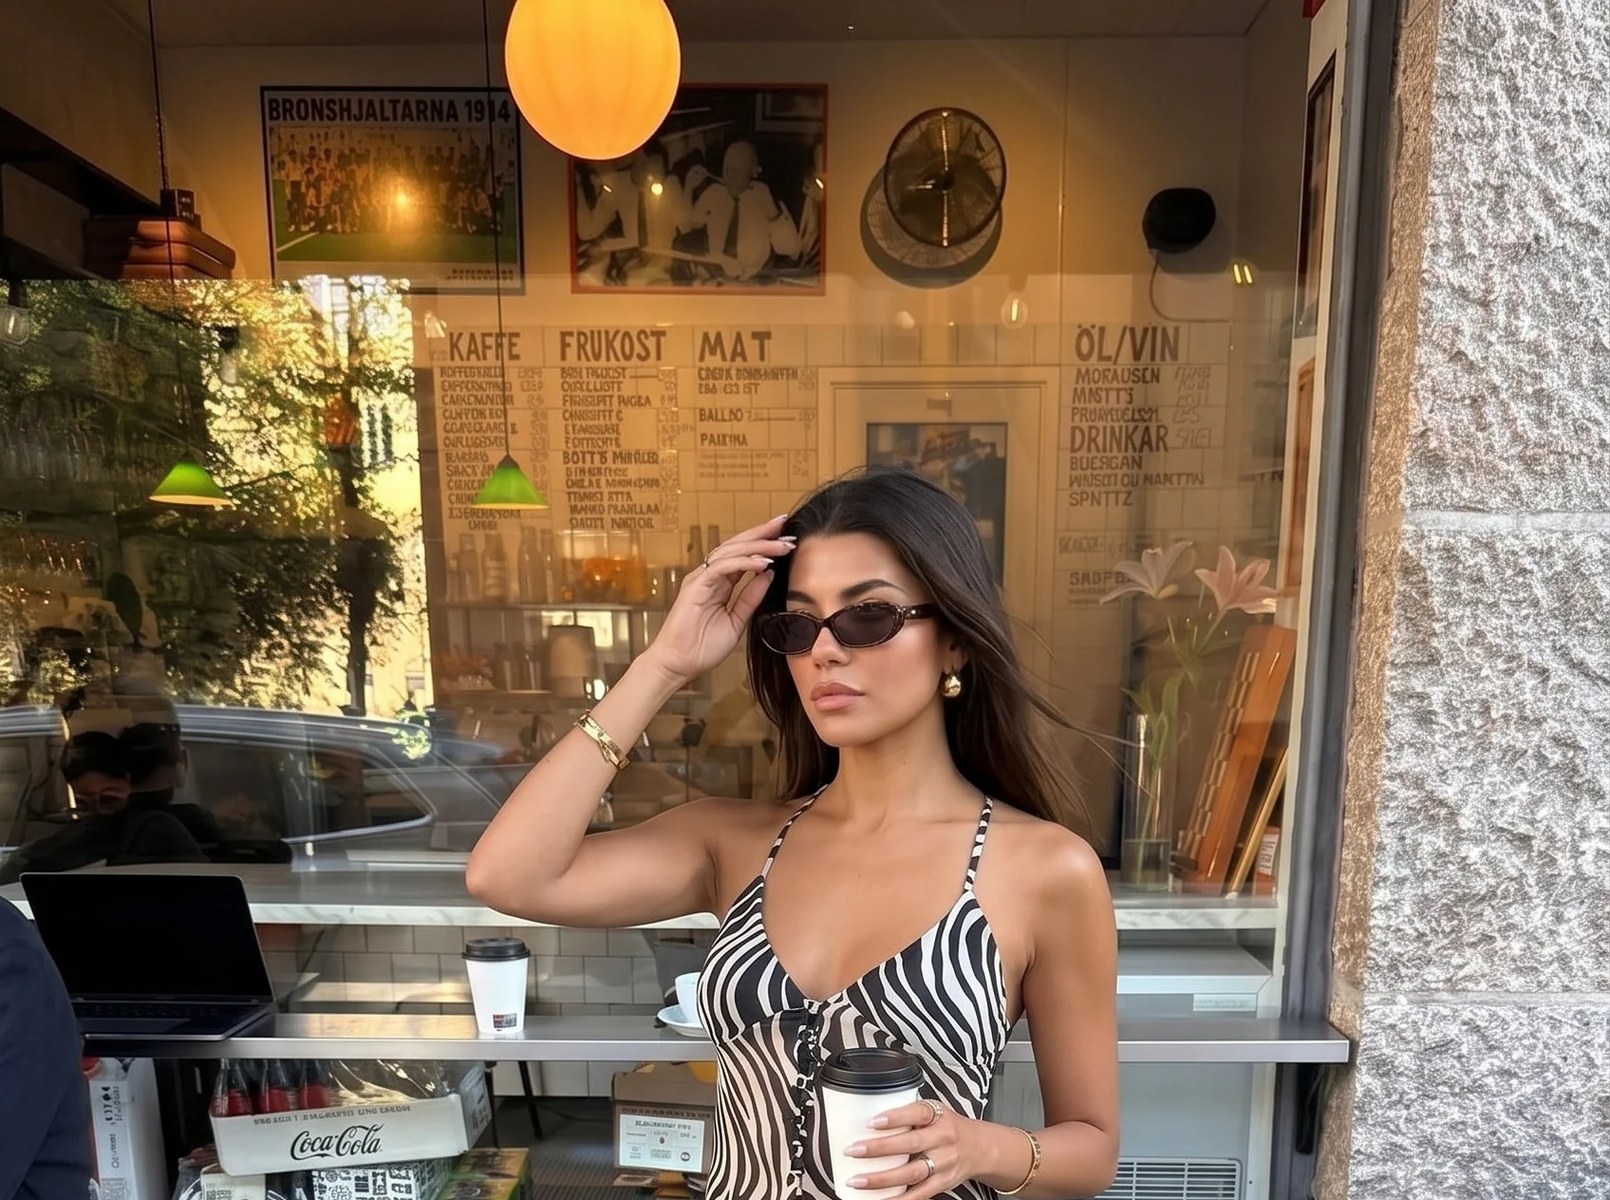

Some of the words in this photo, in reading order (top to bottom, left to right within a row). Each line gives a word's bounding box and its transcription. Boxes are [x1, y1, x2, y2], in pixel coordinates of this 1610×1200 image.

[268, 98, 460, 123] BRONSHJALTARNA
[464, 99, 511, 123] 1914
[450, 331, 521, 362] KAFFE
[560, 329, 667, 362] FRUKOST
[698, 331, 772, 363] MAT
[1075, 324, 1180, 365] ÖL/VIN
[1069, 425, 1169, 453] DRINKAR
[290, 1123, 386, 1161] Coca-Cola
